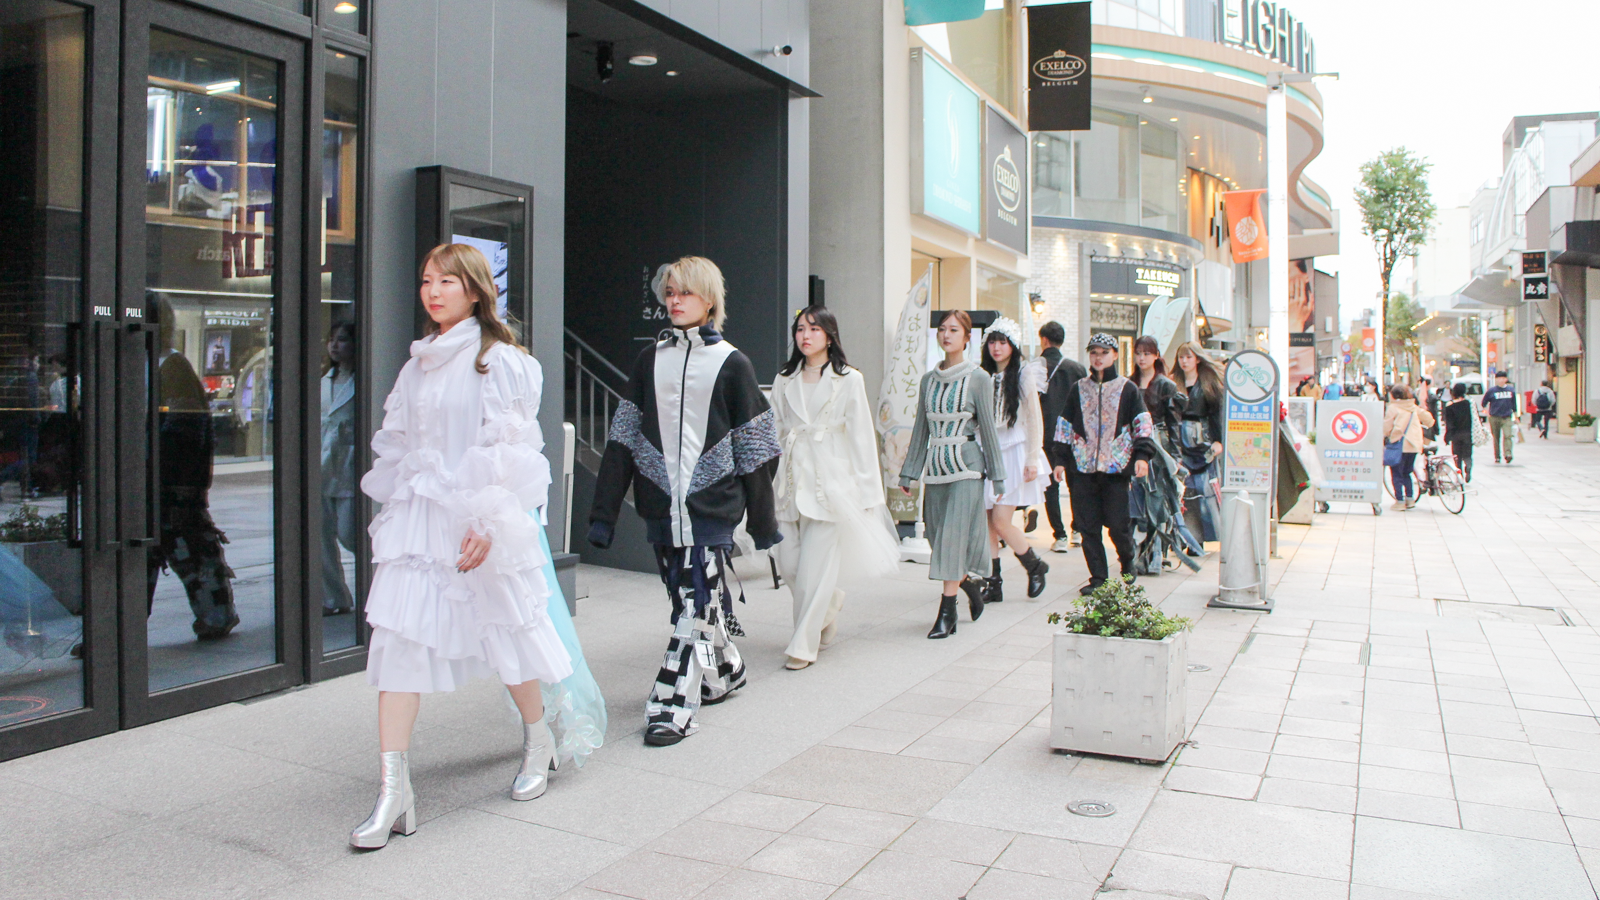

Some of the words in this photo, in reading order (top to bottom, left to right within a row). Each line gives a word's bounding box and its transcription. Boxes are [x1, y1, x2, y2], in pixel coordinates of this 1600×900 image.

[1040, 60, 1082, 70] EXELCO
[996, 164, 1018, 193] EXELCO
[997, 208, 1017, 226] BELGIUM
[93, 305, 111, 316] PULL
[125, 307, 142, 318] PULL
[642, 306, 670, 320] さん
[1494, 391, 1513, 399] YALE
